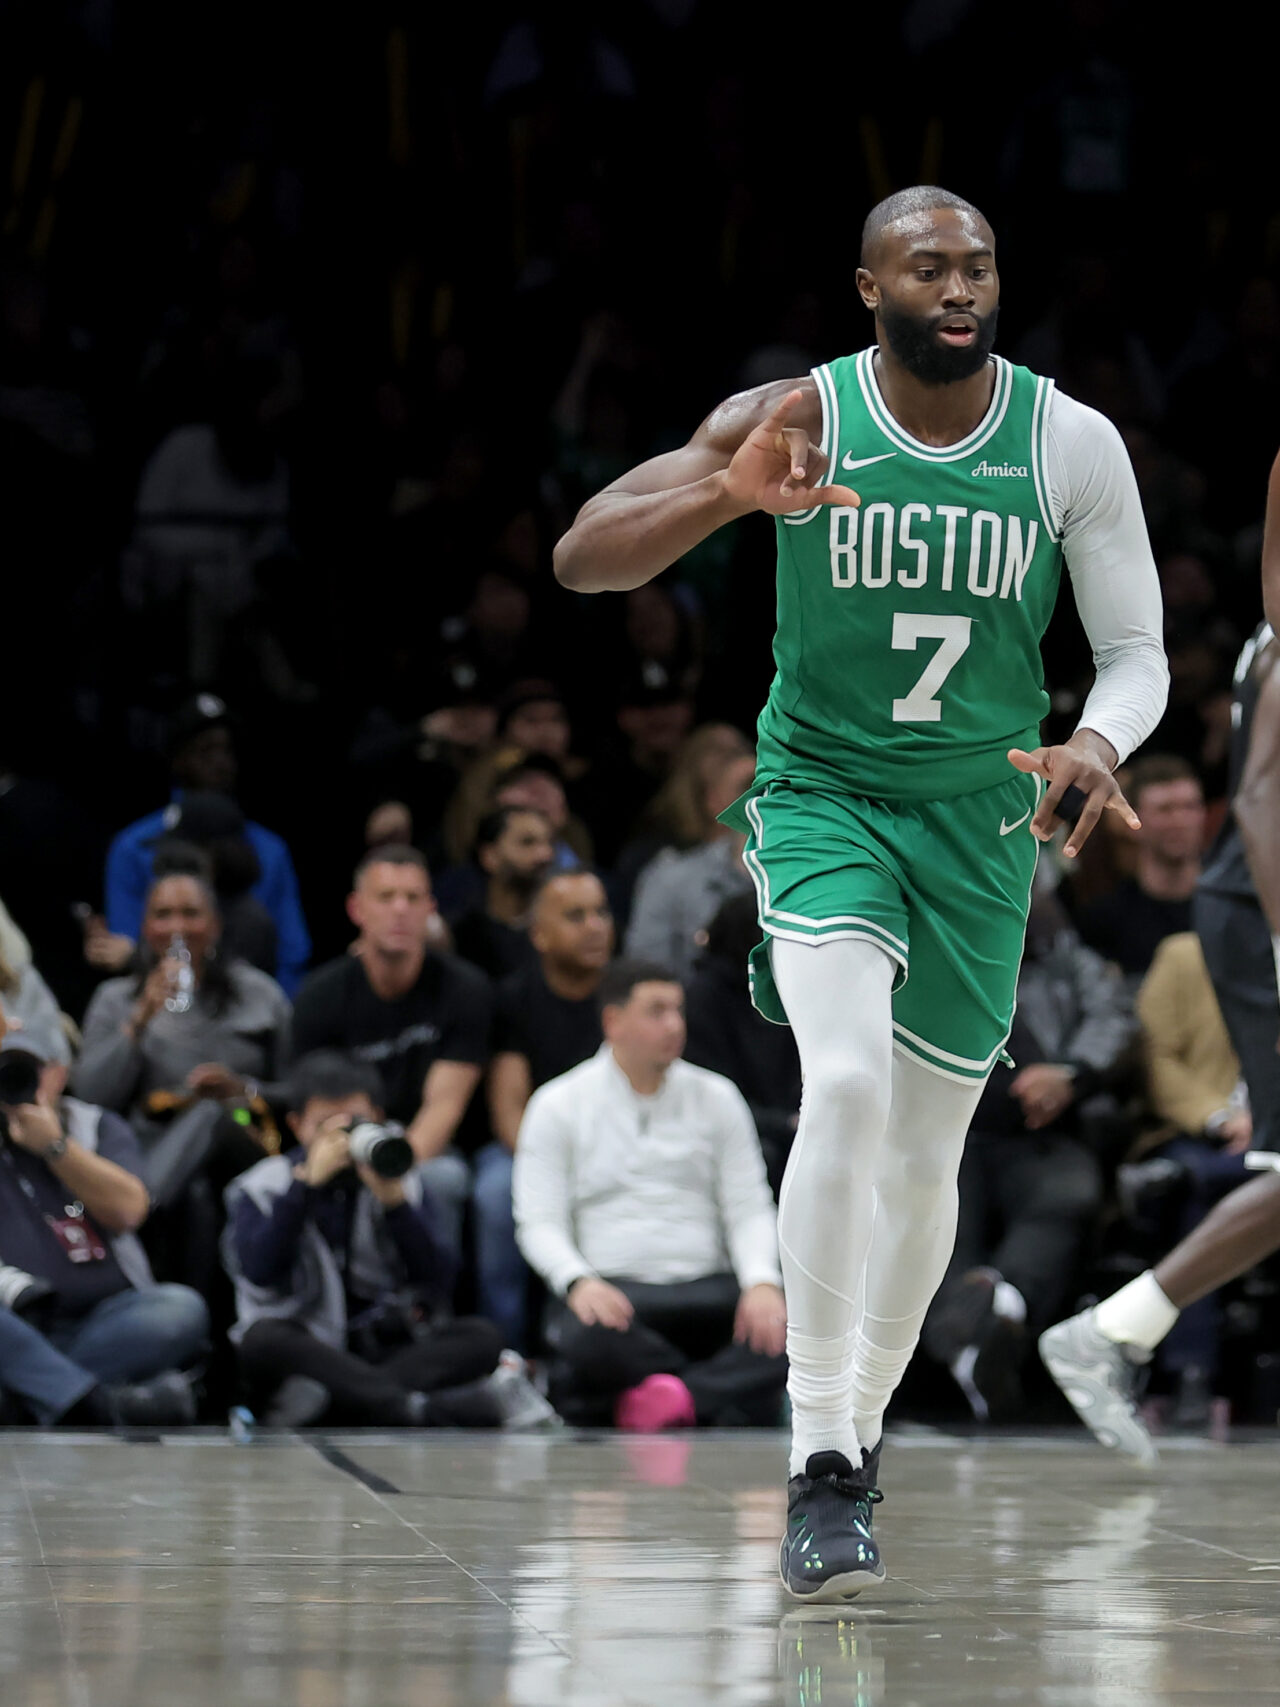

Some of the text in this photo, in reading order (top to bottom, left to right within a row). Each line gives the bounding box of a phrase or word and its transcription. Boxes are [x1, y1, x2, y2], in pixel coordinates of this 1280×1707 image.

[970, 460, 1029, 479] Amica
[829, 502, 1039, 601] BOSTON
[891, 612, 972, 722] 7
